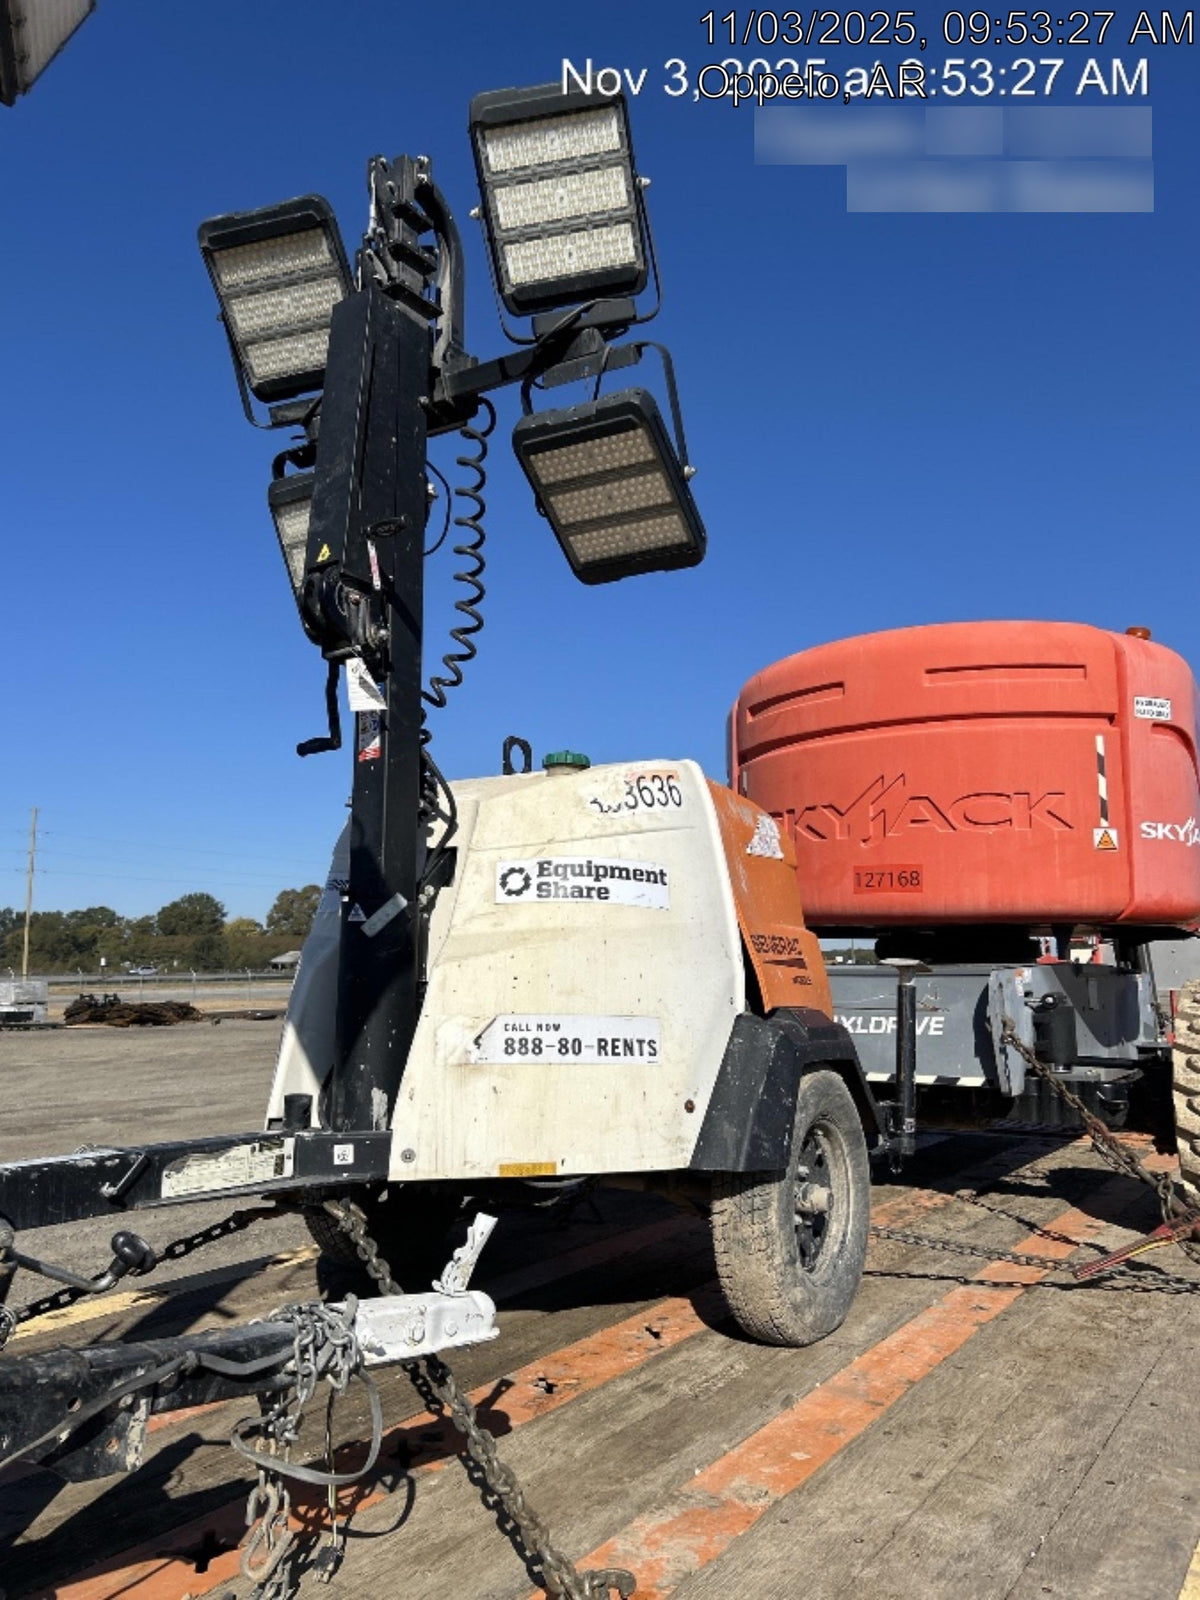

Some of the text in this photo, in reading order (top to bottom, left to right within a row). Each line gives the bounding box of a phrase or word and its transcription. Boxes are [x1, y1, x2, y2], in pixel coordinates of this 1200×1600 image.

[768, 774, 1074, 847] KYJACK
[536, 860, 667, 886] Equipment
[855, 869, 921, 888] 127168
[536, 882, 610, 900] Share
[504, 1023, 561, 1032] CALL NOW
[833, 1015, 945, 1035] XLDRVE
[504, 1037, 657, 1057] 888-80-RENTS
